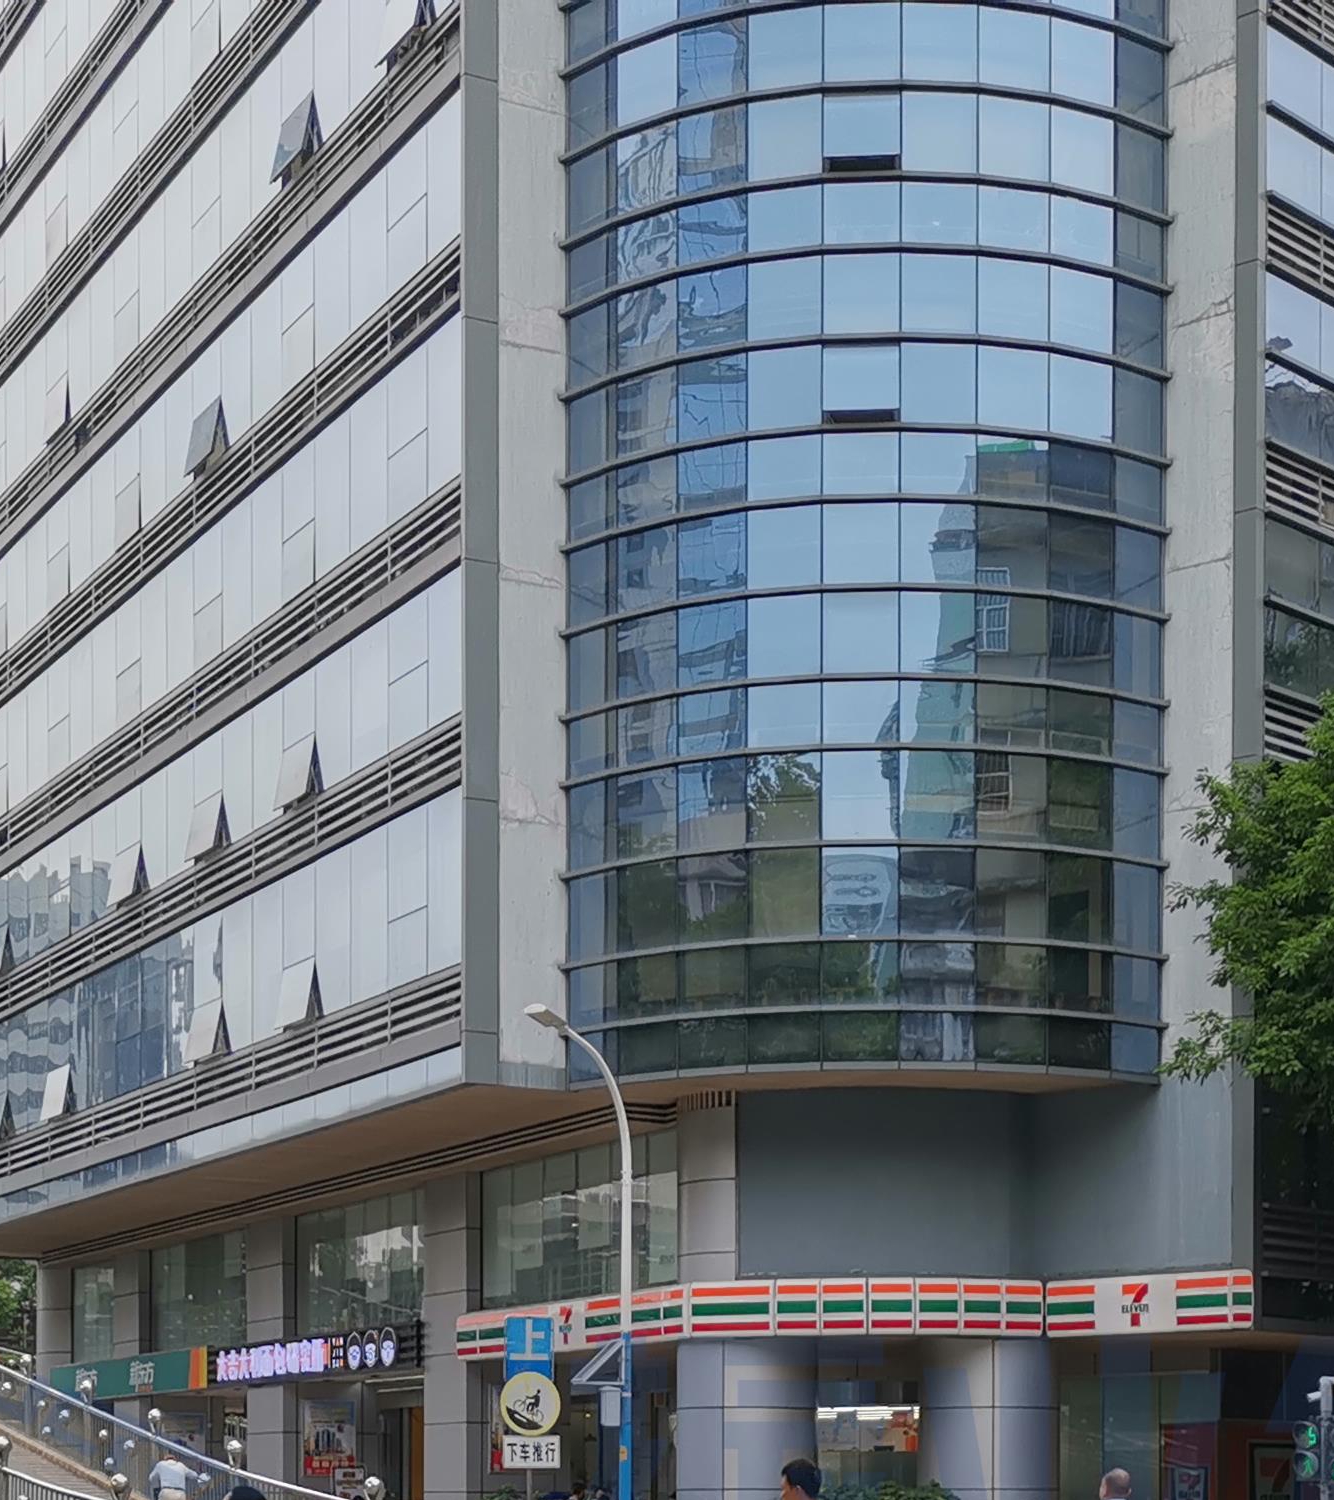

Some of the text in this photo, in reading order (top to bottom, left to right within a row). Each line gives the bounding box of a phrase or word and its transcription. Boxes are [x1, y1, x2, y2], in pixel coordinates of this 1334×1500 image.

[1121, 1283, 1149, 1327] 7
[509, 1318, 549, 1361] 上
[506, 1442, 556, 1463] 下车推行
